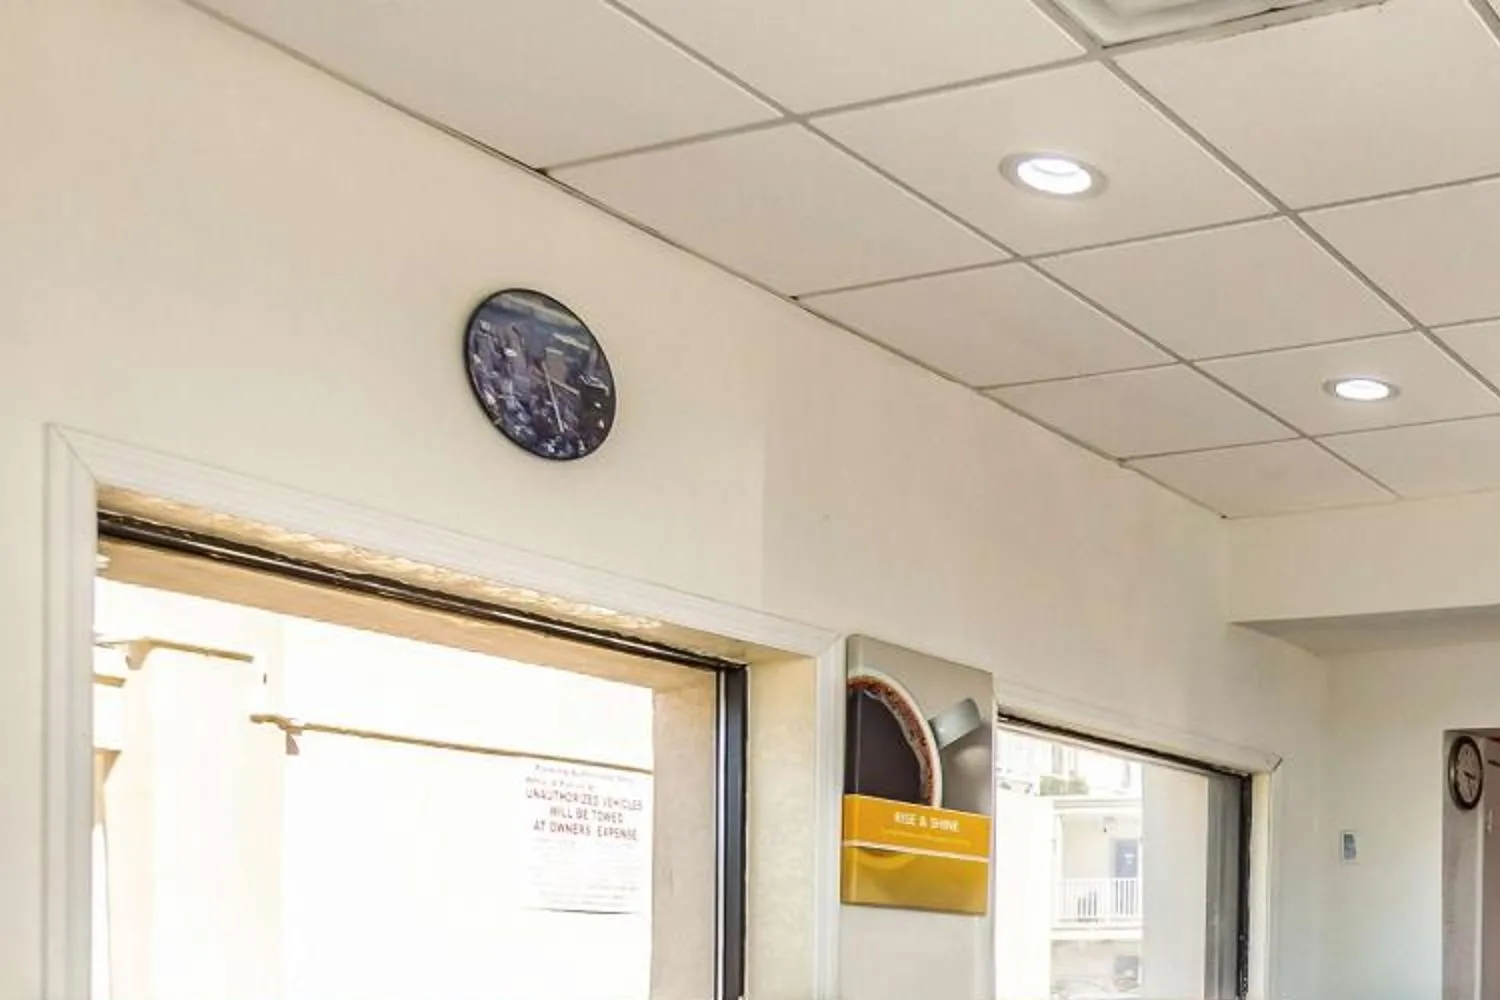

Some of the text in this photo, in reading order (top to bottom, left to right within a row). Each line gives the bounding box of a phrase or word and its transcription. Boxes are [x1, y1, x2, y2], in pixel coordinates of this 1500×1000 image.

[526, 788, 643, 811] UNAUTHORIZED VEHICLES
[549, 806, 624, 824] WILL BE TOWED
[533, 818, 546, 832] AT
[597, 826, 637, 841] EXPENSE
